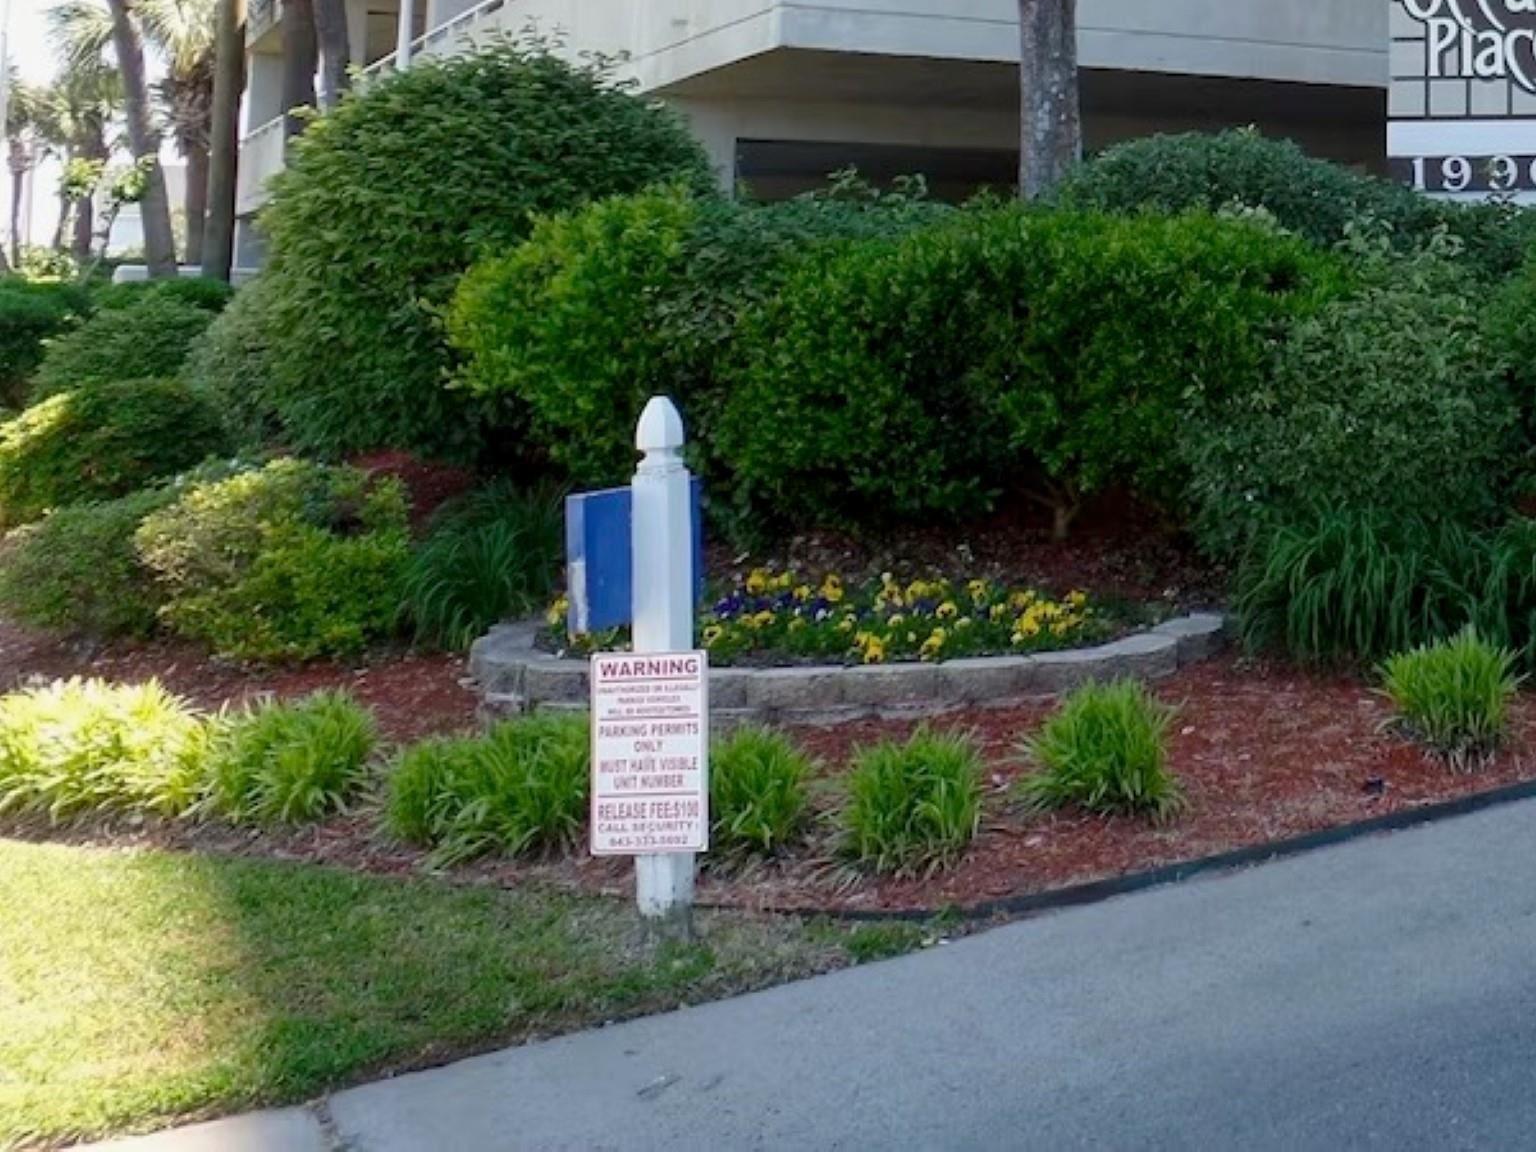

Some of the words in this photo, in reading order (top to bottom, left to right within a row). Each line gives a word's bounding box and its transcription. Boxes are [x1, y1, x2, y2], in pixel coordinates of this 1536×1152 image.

[600, 659, 698, 677] WARNING
[600, 724, 647, 738] PARKING
[651, 723, 699, 736] PERMITS
[634, 741, 663, 753] ONLY
[600, 760, 627, 773] MUST
[631, 758, 656, 772] HAVE
[661, 757, 697, 770] VISIBLE
[613, 776, 638, 790] UNIT
[641, 775, 683, 788] NUMBER
[599, 802, 647, 819] RELEASE
[599, 823, 628, 834] CALL
